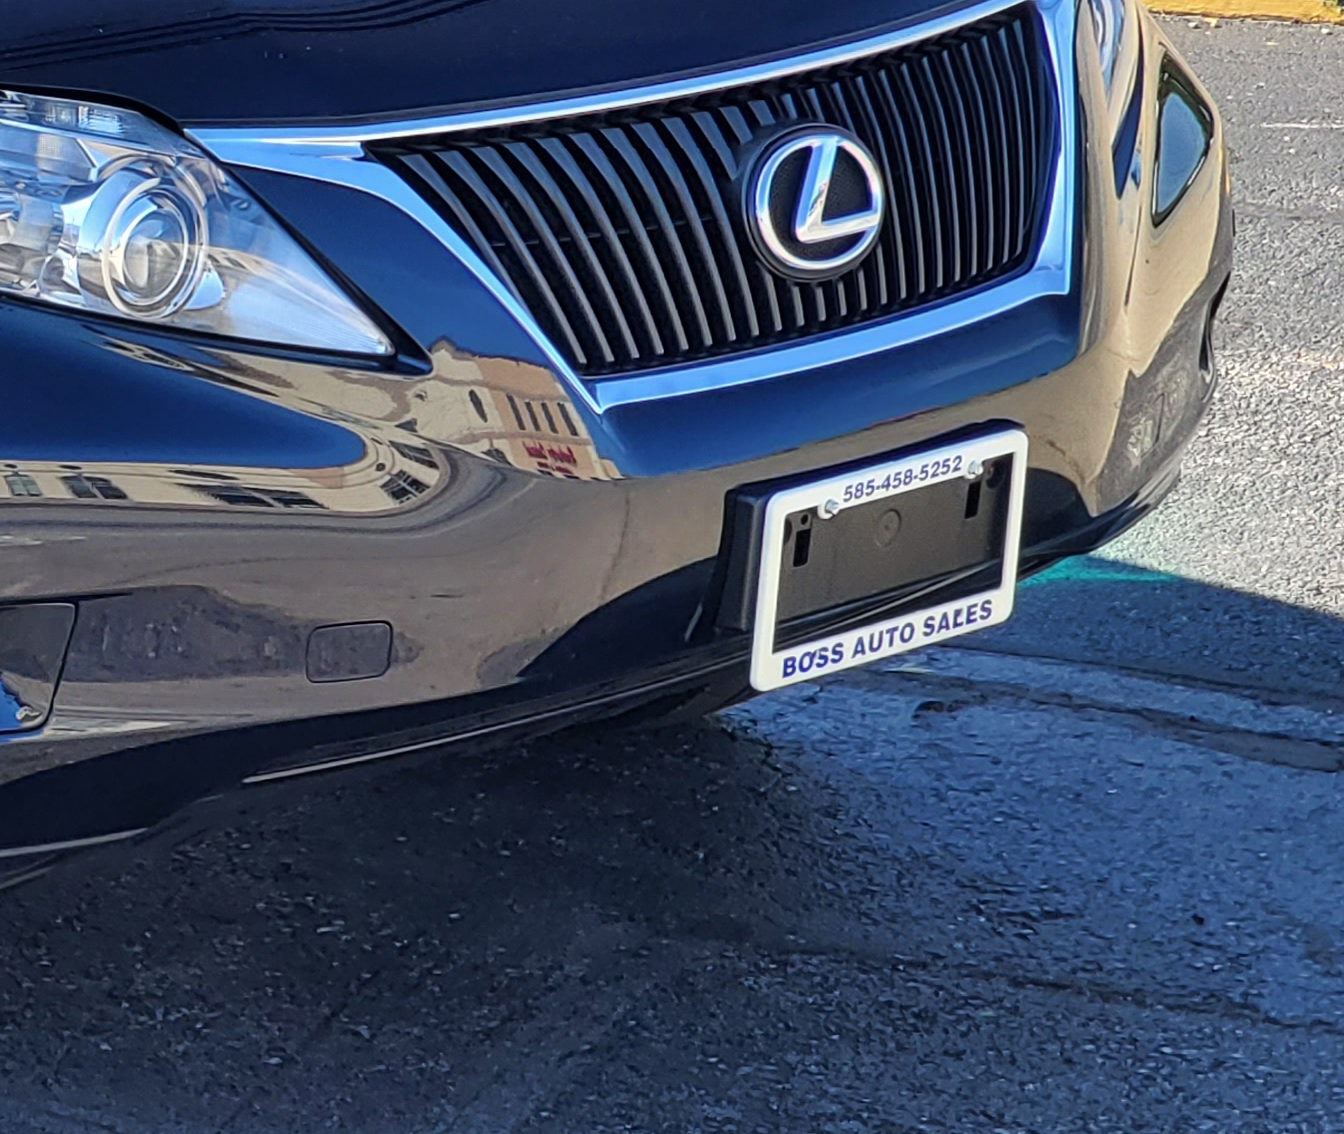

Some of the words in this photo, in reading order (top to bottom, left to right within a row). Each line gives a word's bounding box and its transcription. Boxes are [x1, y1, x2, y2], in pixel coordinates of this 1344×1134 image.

[842, 455, 963, 503] 585-458-5252
[781, 642, 845, 679] BOSS
[851, 622, 916, 659] AUTO
[922, 599, 994, 637] SALES
